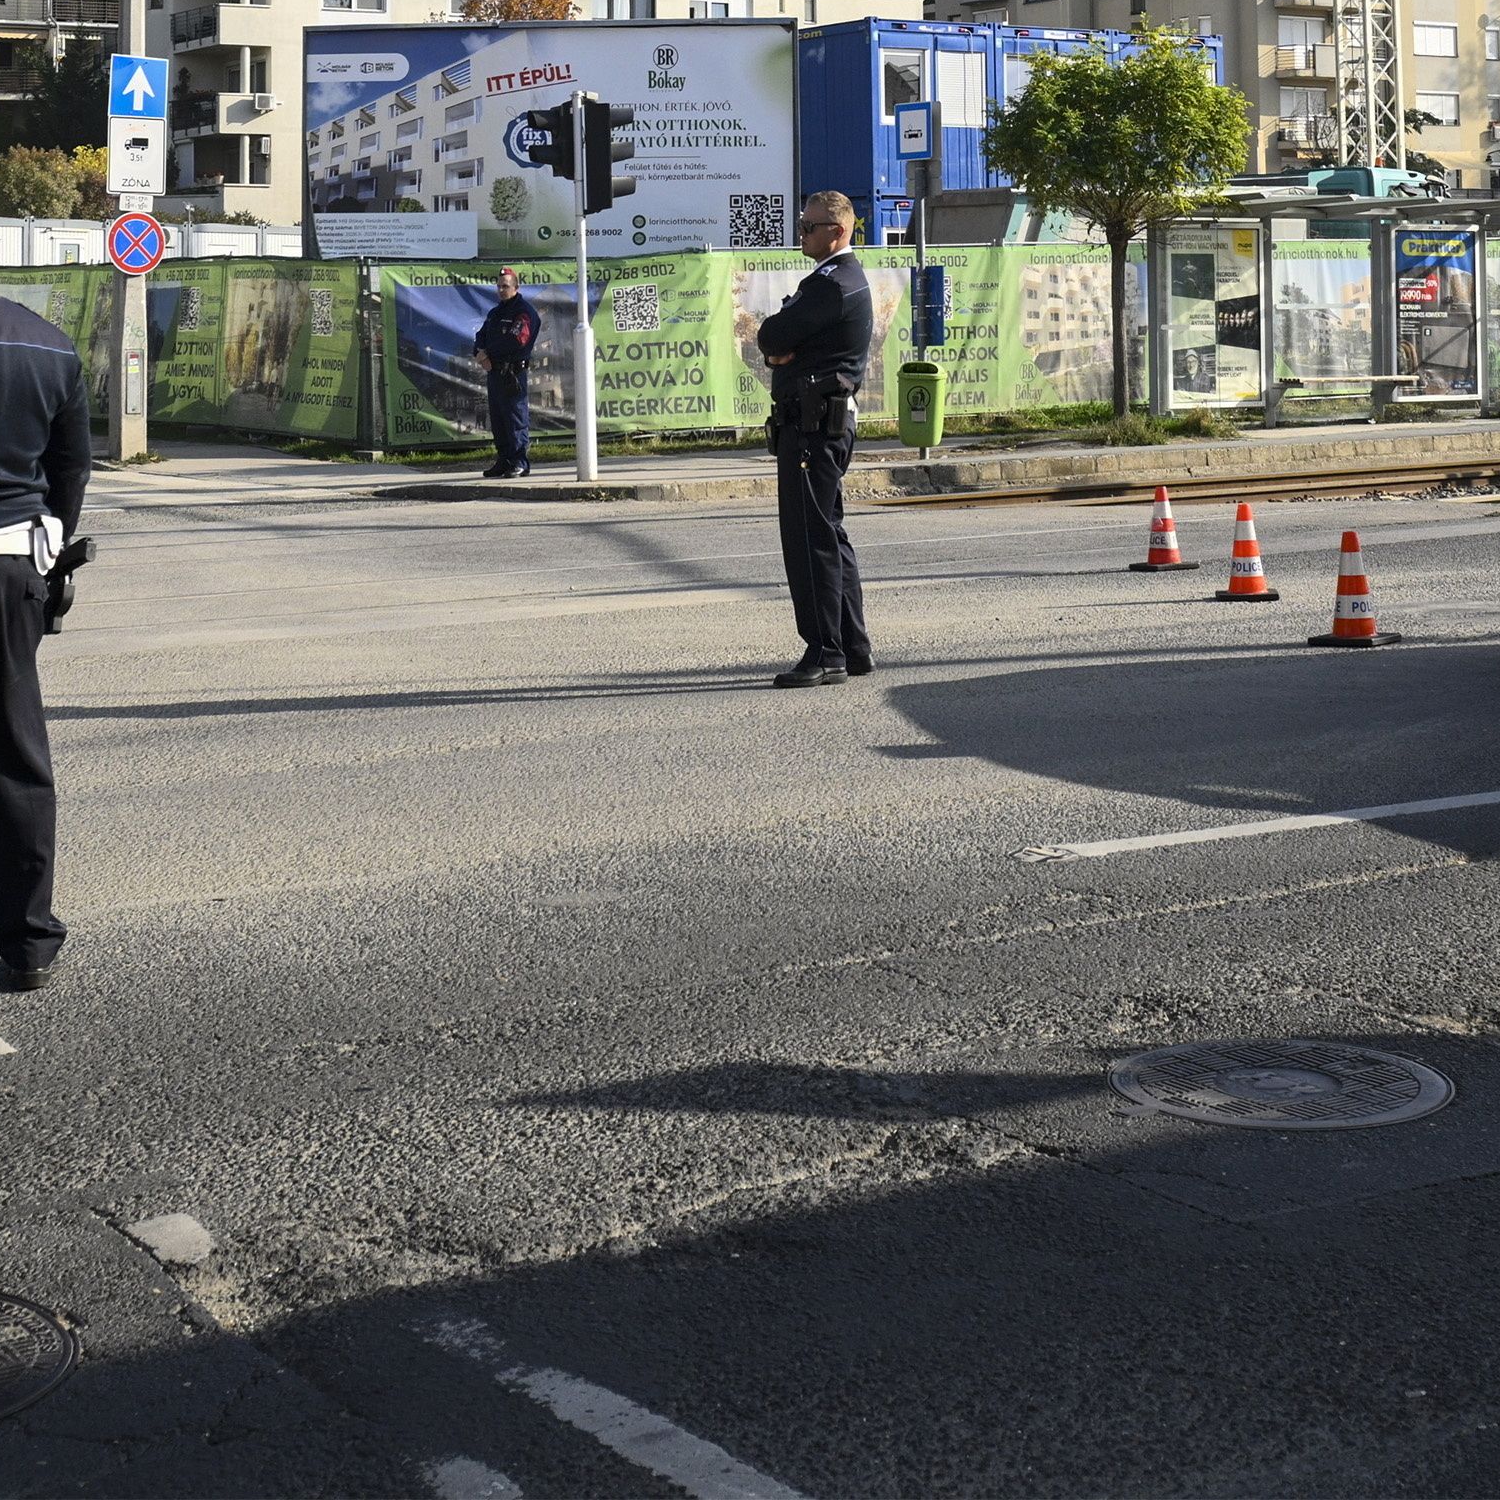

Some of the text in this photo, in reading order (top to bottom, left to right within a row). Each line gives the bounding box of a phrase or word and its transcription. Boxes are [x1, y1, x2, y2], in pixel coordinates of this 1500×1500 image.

[657, 48, 674, 66] BR
[486, 63, 572, 92] ITT ÉPÜL!
[648, 70, 686, 92] Bókay
[522, 128, 542, 139] fix
[122, 177, 150, 187] ZÓNA
[602, 228, 623, 236] 9002
[1272, 246, 1358, 261] orinciotthonok.hu
[1408, 241, 1461, 253] Praktiker
[900, 256, 914, 268] 20
[940, 255, 968, 268] 9002
[410, 272, 550, 286] lorinciotthok.hu
[594, 268, 610, 281] 20
[614, 267, 638, 280] 268
[642, 263, 676, 278] 9002
[594, 340, 709, 363] AZ OTTHON
[600, 362, 704, 391] AHOVÁ JÓ
[739, 376, 754, 392] BR
[403, 393, 420, 410] BR
[1015, 383, 1043, 402] Bókay
[595, 393, 716, 419] MEGÉRKEZNI
[733, 395, 765, 415] Bókay
[395, 415, 433, 435] Bókay
